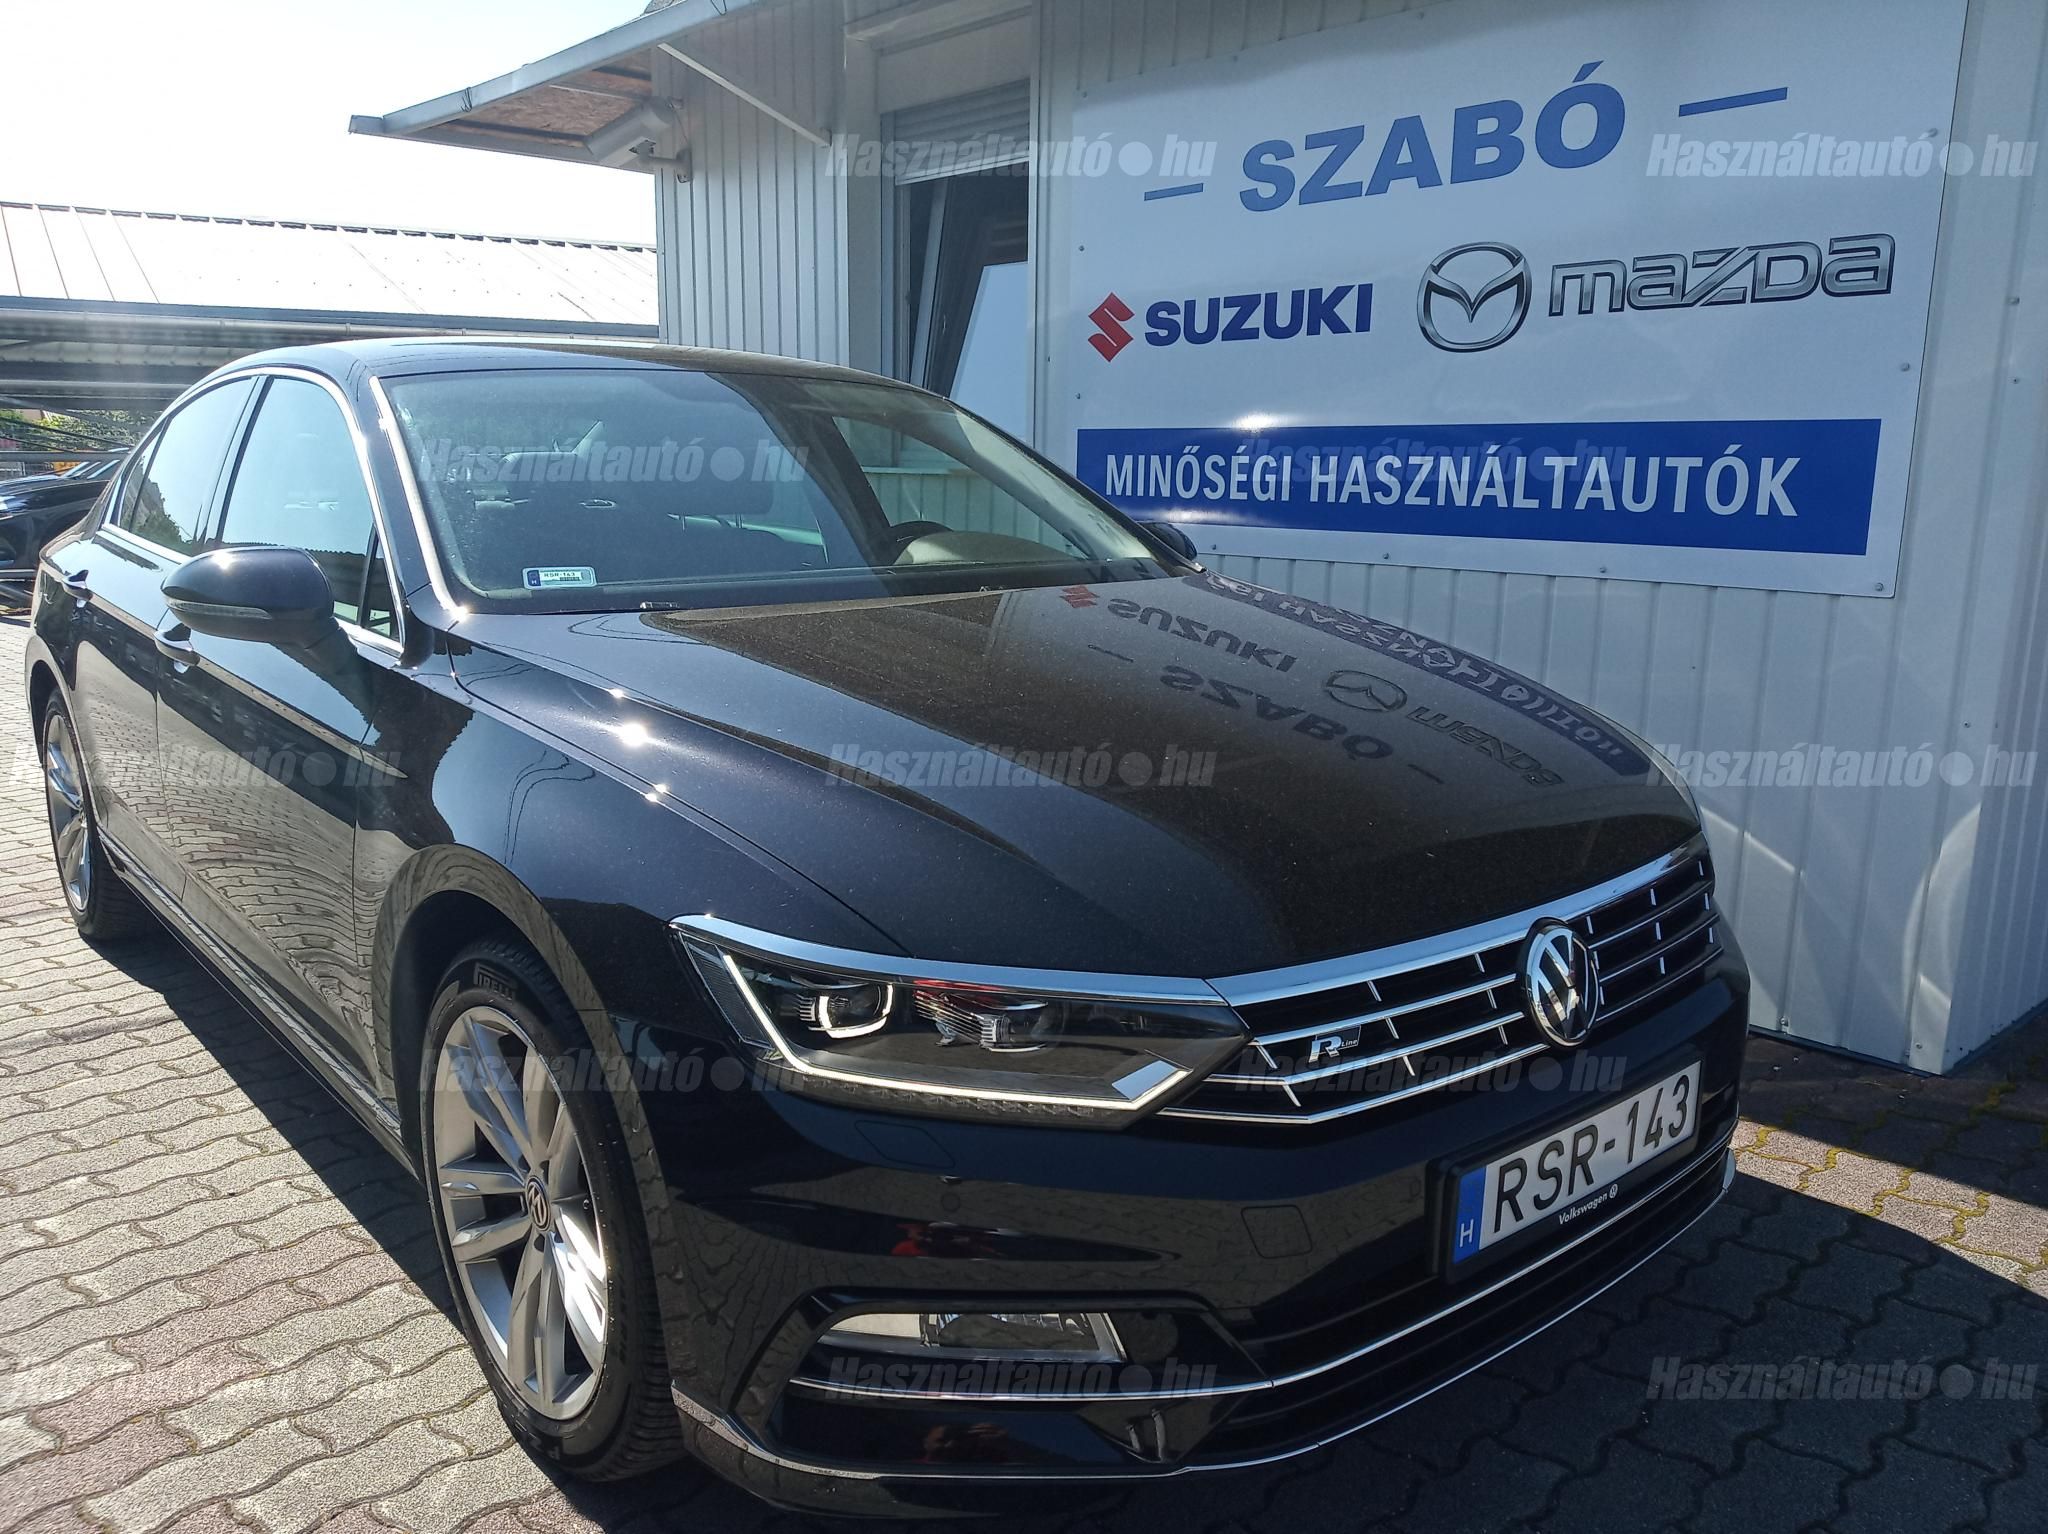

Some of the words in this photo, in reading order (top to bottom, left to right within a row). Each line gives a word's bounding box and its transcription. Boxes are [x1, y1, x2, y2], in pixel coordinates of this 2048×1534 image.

[1239, 61, 1626, 212] SZABÓ
[1145, 284, 1373, 348] SUZUKI
[1106, 444, 1292, 502] MINŐSÉGI
[1309, 443, 1800, 518] HASZNÁLTAUTÓK
[1494, 1074, 1690, 1234] RSR-143
[1459, 1218, 1474, 1248] H
[1558, 1191, 1608, 1226] Volkswagen
